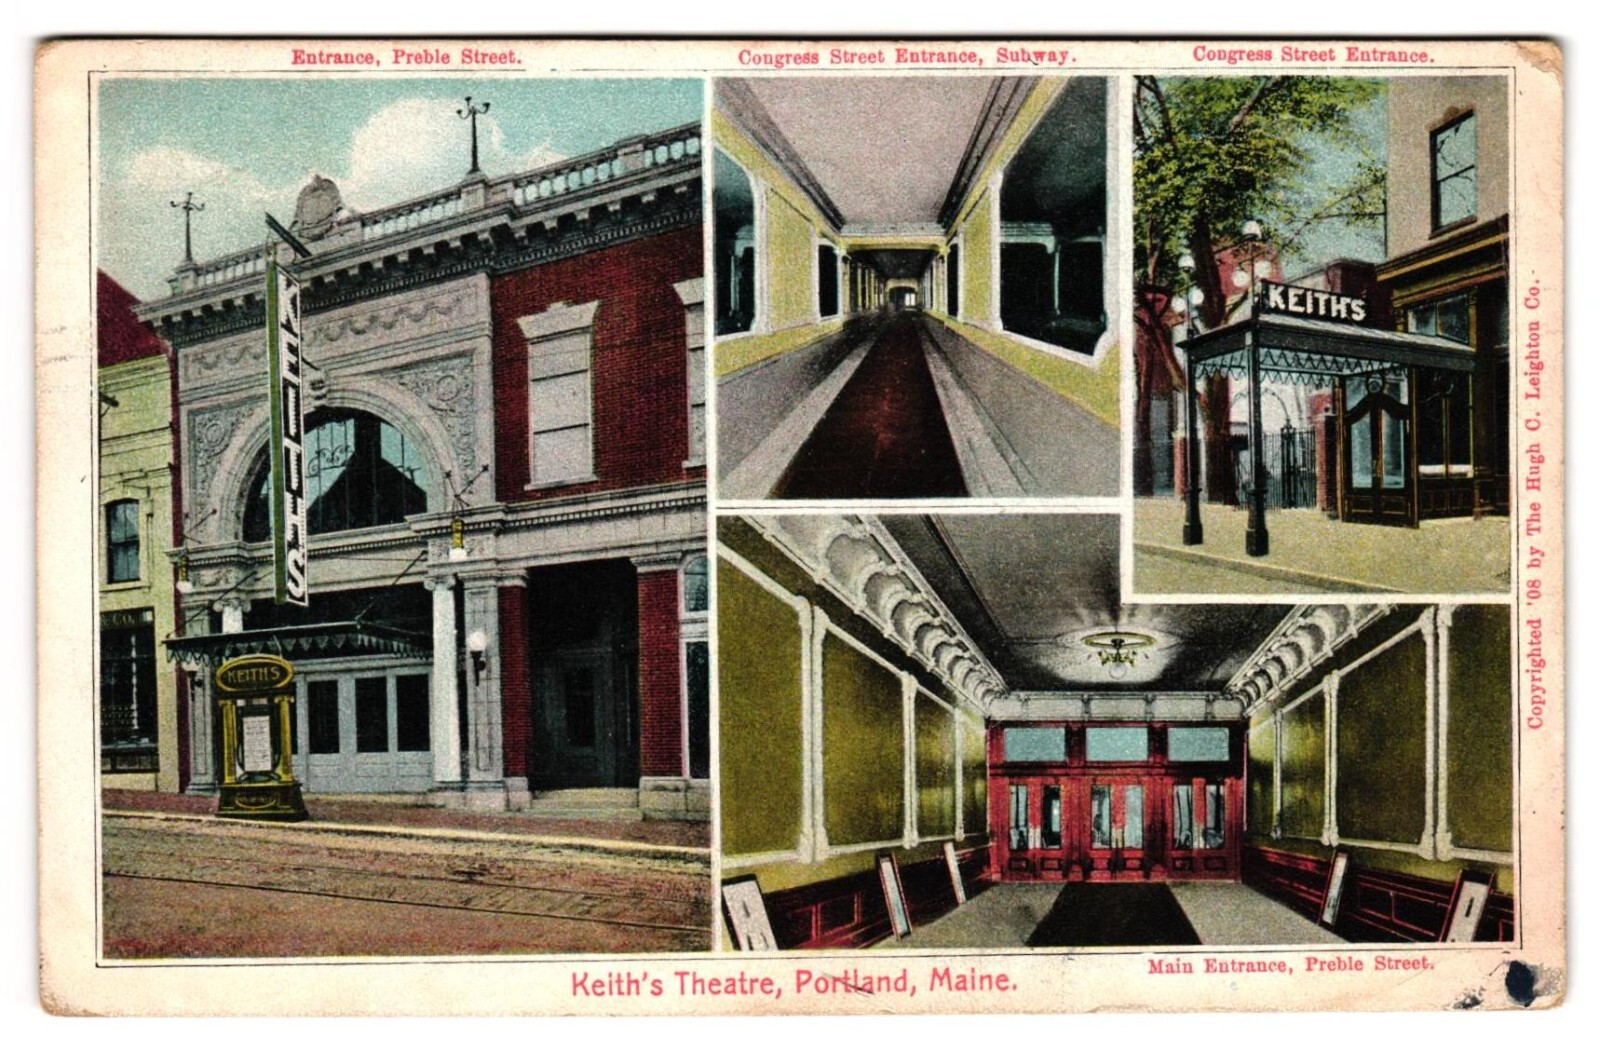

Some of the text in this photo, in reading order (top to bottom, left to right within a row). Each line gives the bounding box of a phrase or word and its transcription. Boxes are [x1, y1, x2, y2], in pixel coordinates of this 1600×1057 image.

[292, 47, 521, 65] Entrance, Preble Street.
[738, 47, 1077, 68] Congress Street Entrance, Subway.
[1193, 45, 1435, 64] Congress Street Entrance.
[1524, 279, 1547, 730] Copyrighted '08 by The Hugh C. Leighton Co.
[1149, 955, 1435, 975] Main Entrance, Preble Street.
[572, 967, 1018, 999] Keith's Theatre, Portland, Maine.
